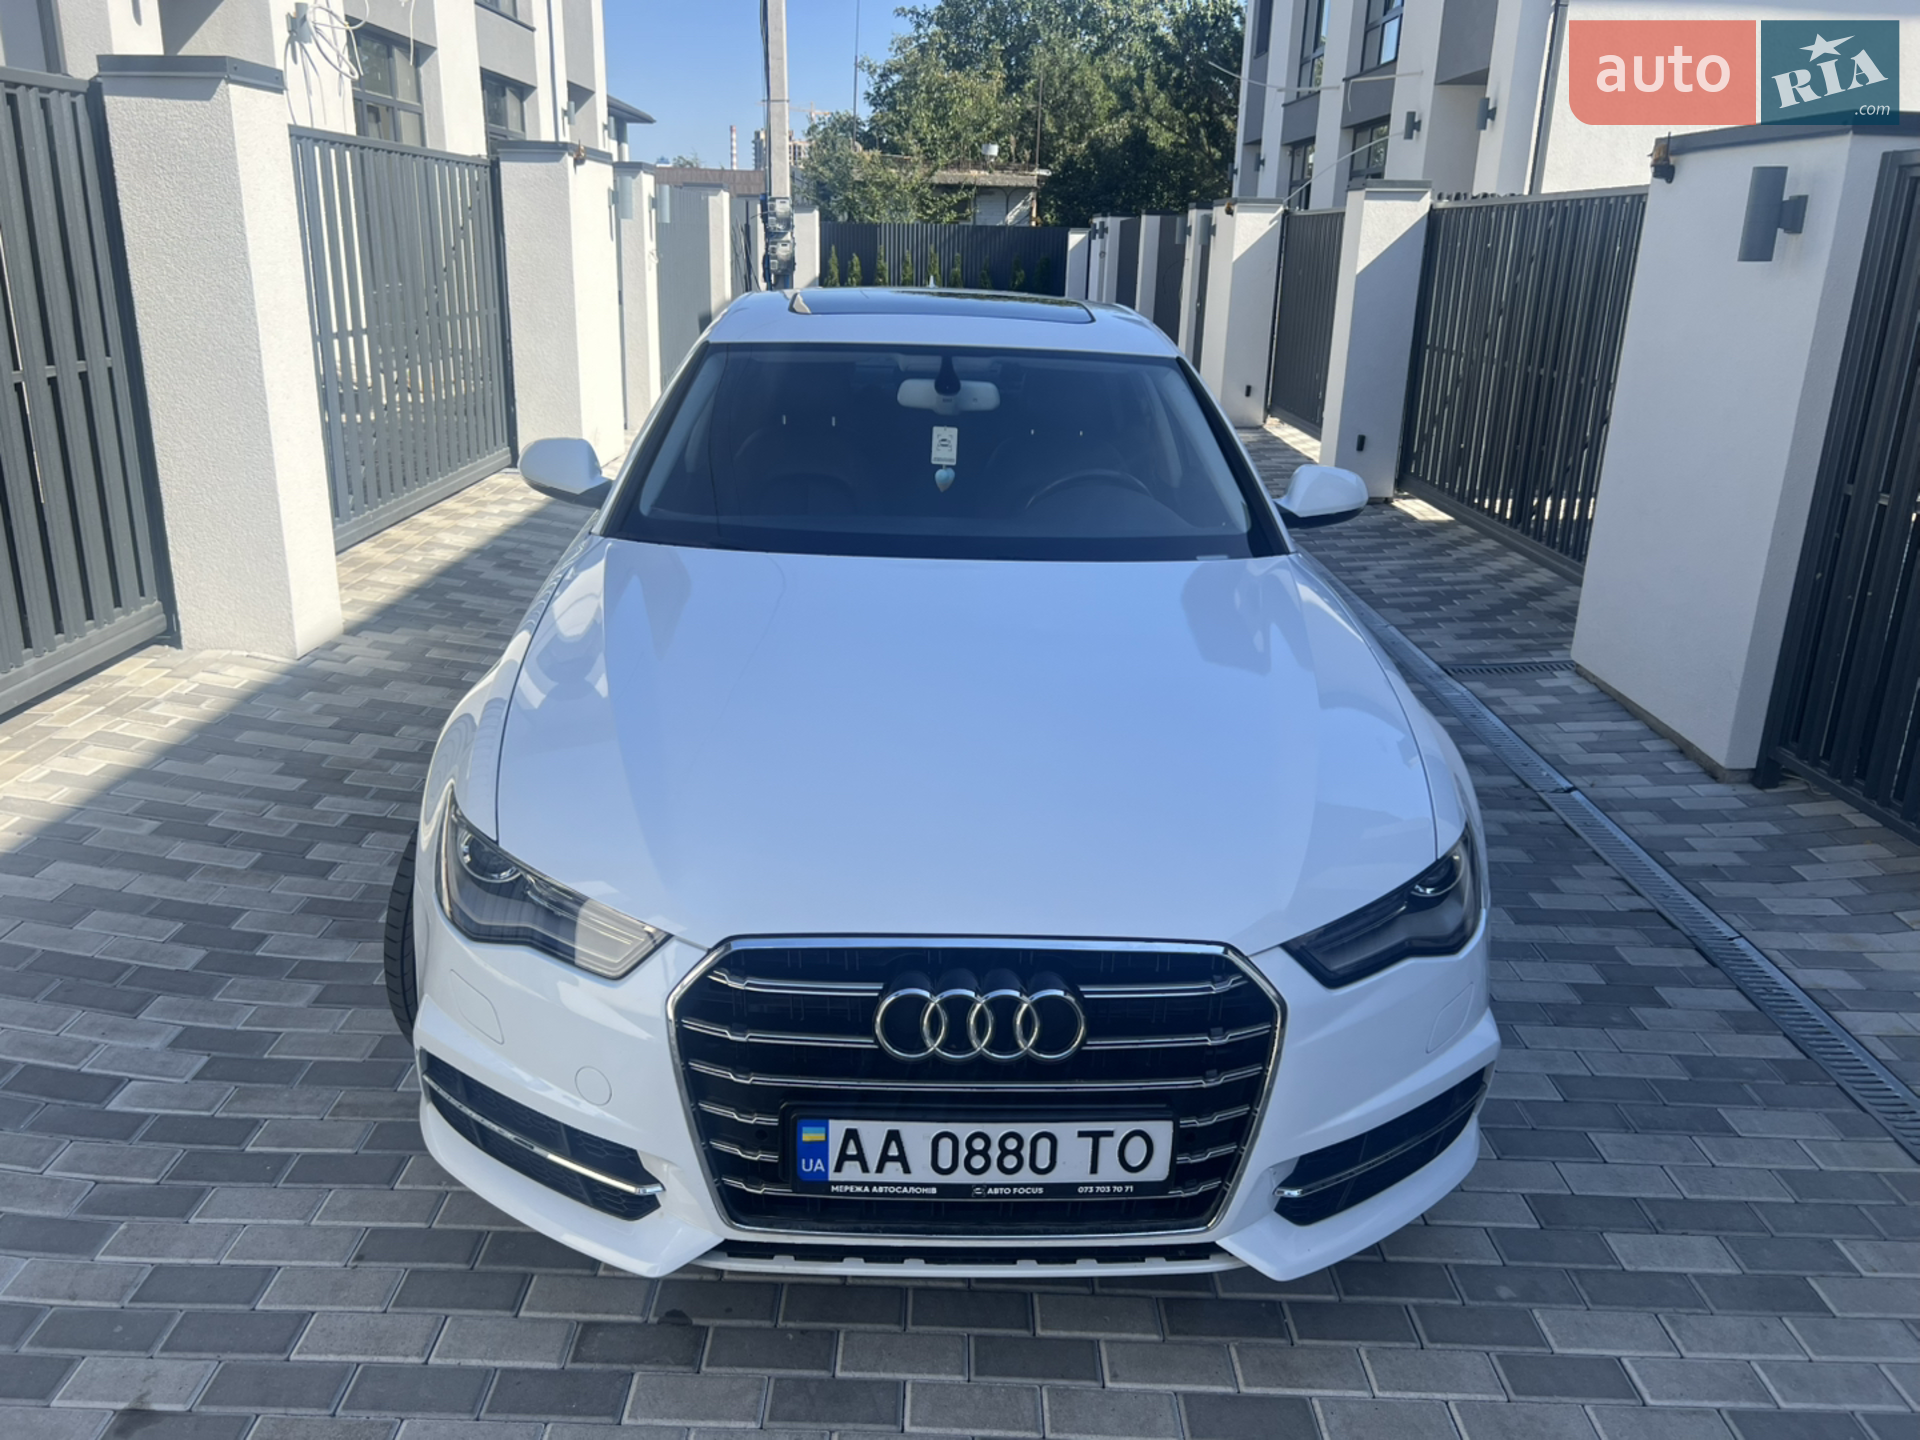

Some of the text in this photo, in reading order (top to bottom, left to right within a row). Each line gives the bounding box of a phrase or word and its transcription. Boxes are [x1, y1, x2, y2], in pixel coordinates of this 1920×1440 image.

[832, 1127, 1155, 1176] AA 0880 TO
[801, 1158, 826, 1172] UA
[831, 1185, 871, 1193] МЕРЕЖА
[1013, 1187, 1045, 1195] FOCUS
[1077, 1186, 1094, 1194] 073
[1112, 1185, 1124, 1193] 70
[1125, 1185, 1134, 1193] 71
